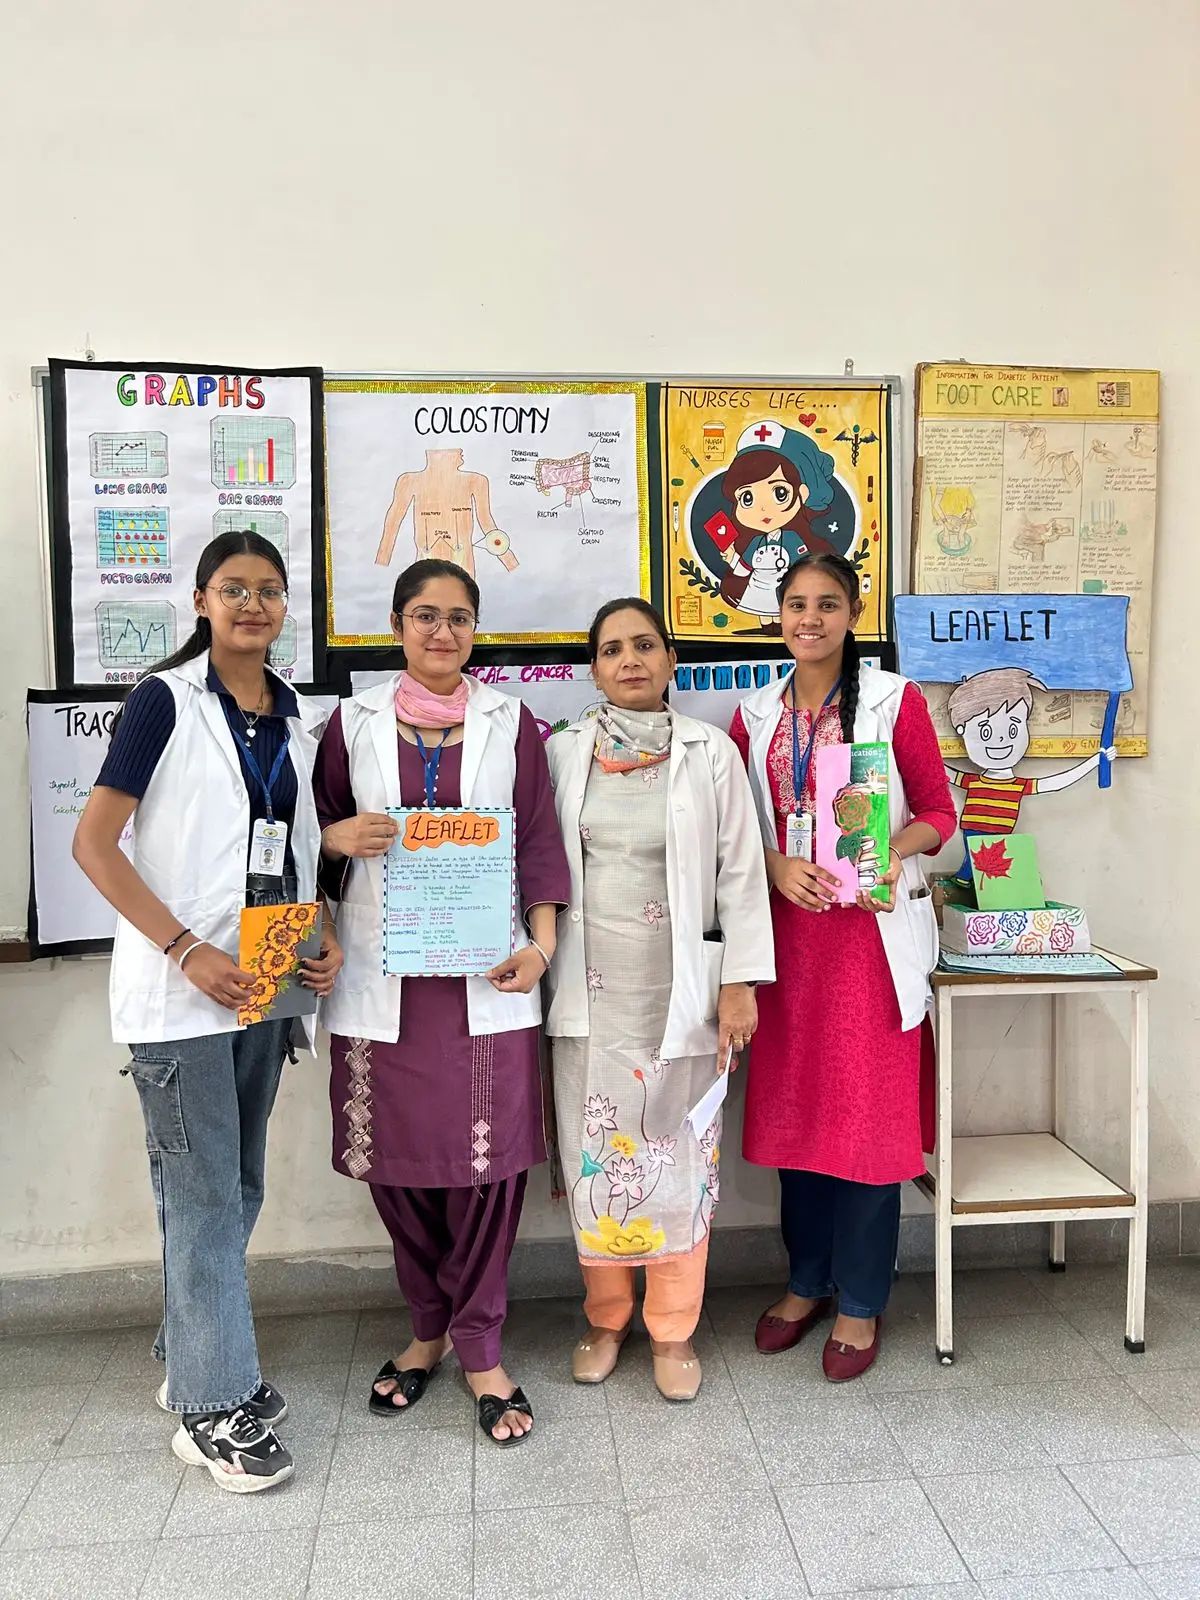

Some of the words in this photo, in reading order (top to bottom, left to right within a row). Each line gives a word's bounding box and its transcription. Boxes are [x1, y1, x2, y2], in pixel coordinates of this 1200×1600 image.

[116, 374, 266, 409] GRAPHS
[678, 390, 752, 409] NURSES
[936, 384, 984, 405] FOOT
[992, 385, 1042, 406] CARE
[414, 406, 550, 435] COLOSTOMY
[127, 483, 167, 495] GRAPH
[218, 493, 242, 505] BAR
[245, 494, 283, 506] GRAPH
[592, 498, 621, 507] COLOSTOMY
[537, 510, 558, 518] RECTUM
[577, 528, 604, 536] SIGMOID
[101, 572, 172, 585] PICTOGRAPH
[930, 610, 1057, 642] LEAFLET
[521, 664, 573, 683] CANCER
[673, 664, 770, 691] HUMAN
[410, 815, 495, 841] LEAFLET
